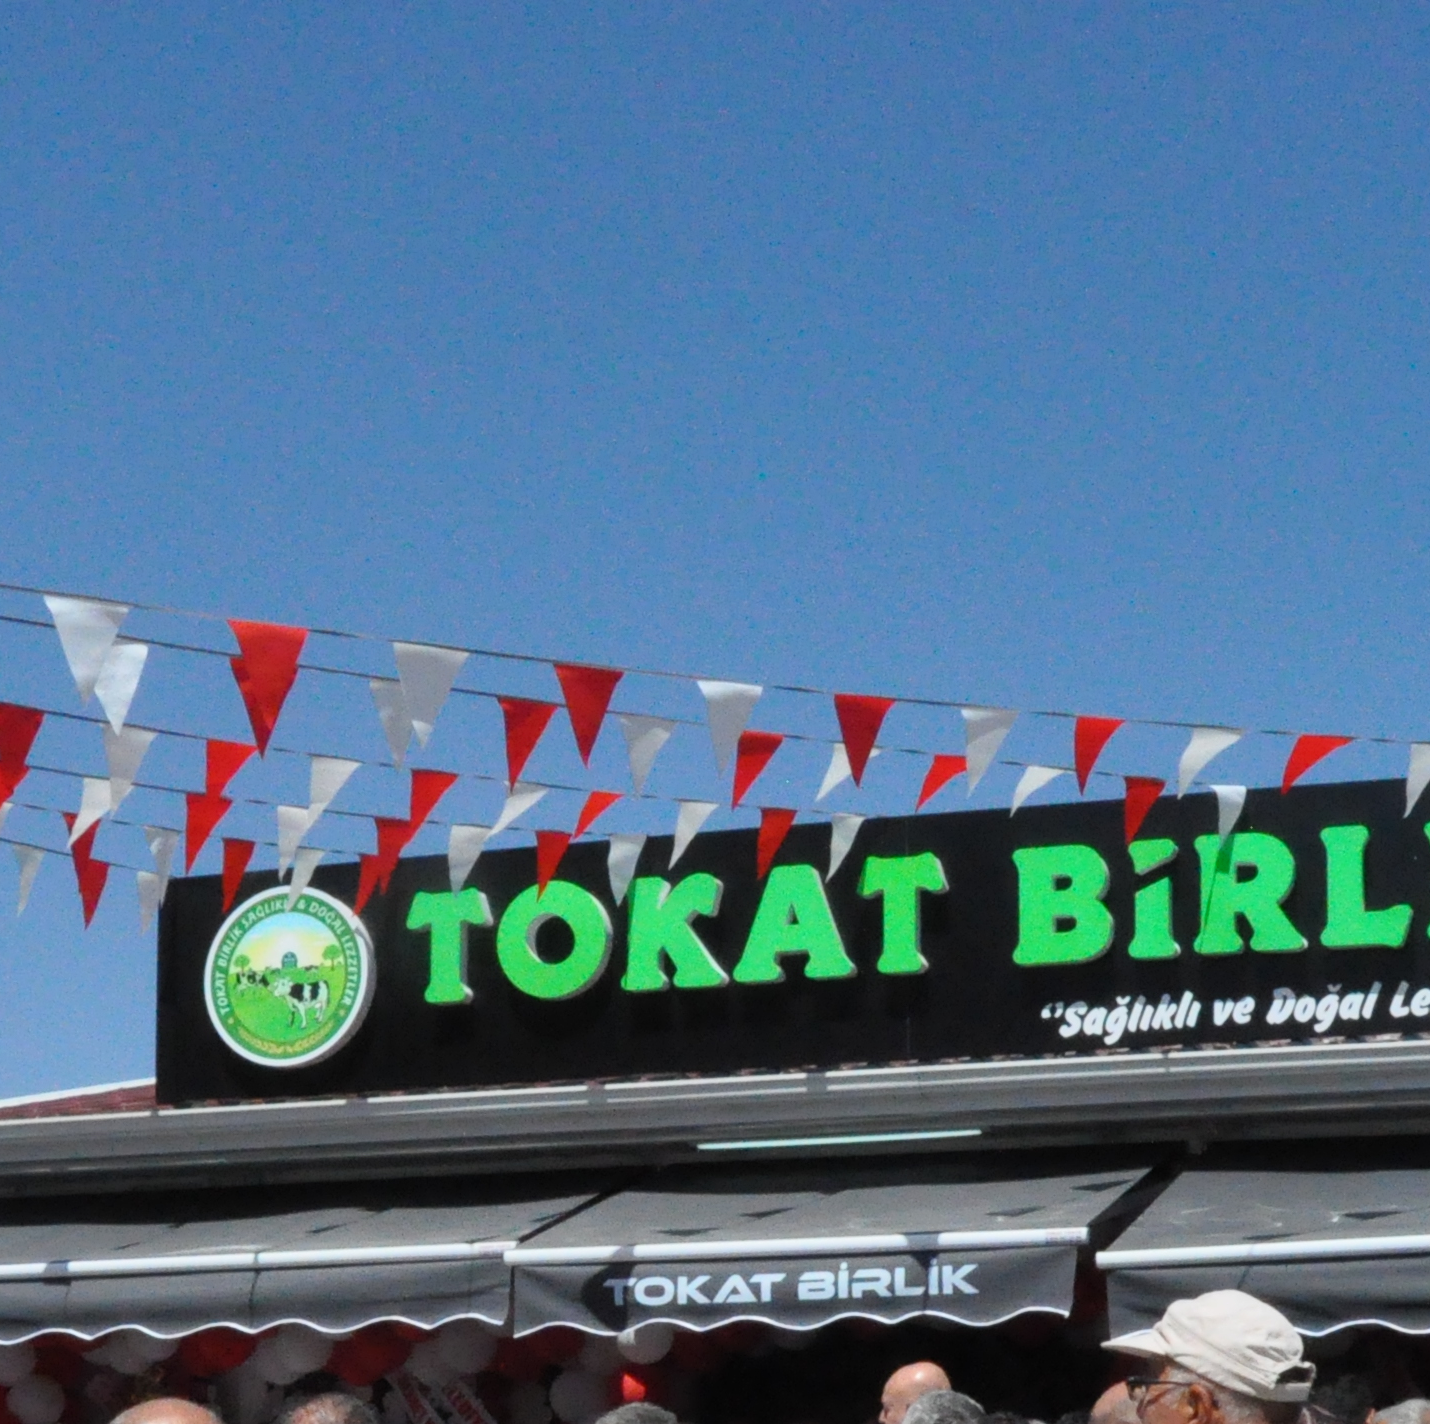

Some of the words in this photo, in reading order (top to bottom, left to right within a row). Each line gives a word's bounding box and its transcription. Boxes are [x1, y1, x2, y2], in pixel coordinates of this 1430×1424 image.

[308, 901, 346, 935] DOĞAL
[406, 850, 948, 1004] TOKAT
[220, 928, 243, 967] BİRLİK
[341, 932, 357, 1006] LEZZETLER
[214, 972, 231, 1016] TOKAT
[1212, 994, 1256, 1027] ve
[1266, 980, 1382, 1033] Doğal
[603, 1272, 787, 1307] TOKAT
[797, 1261, 980, 1302] BİRLİK
